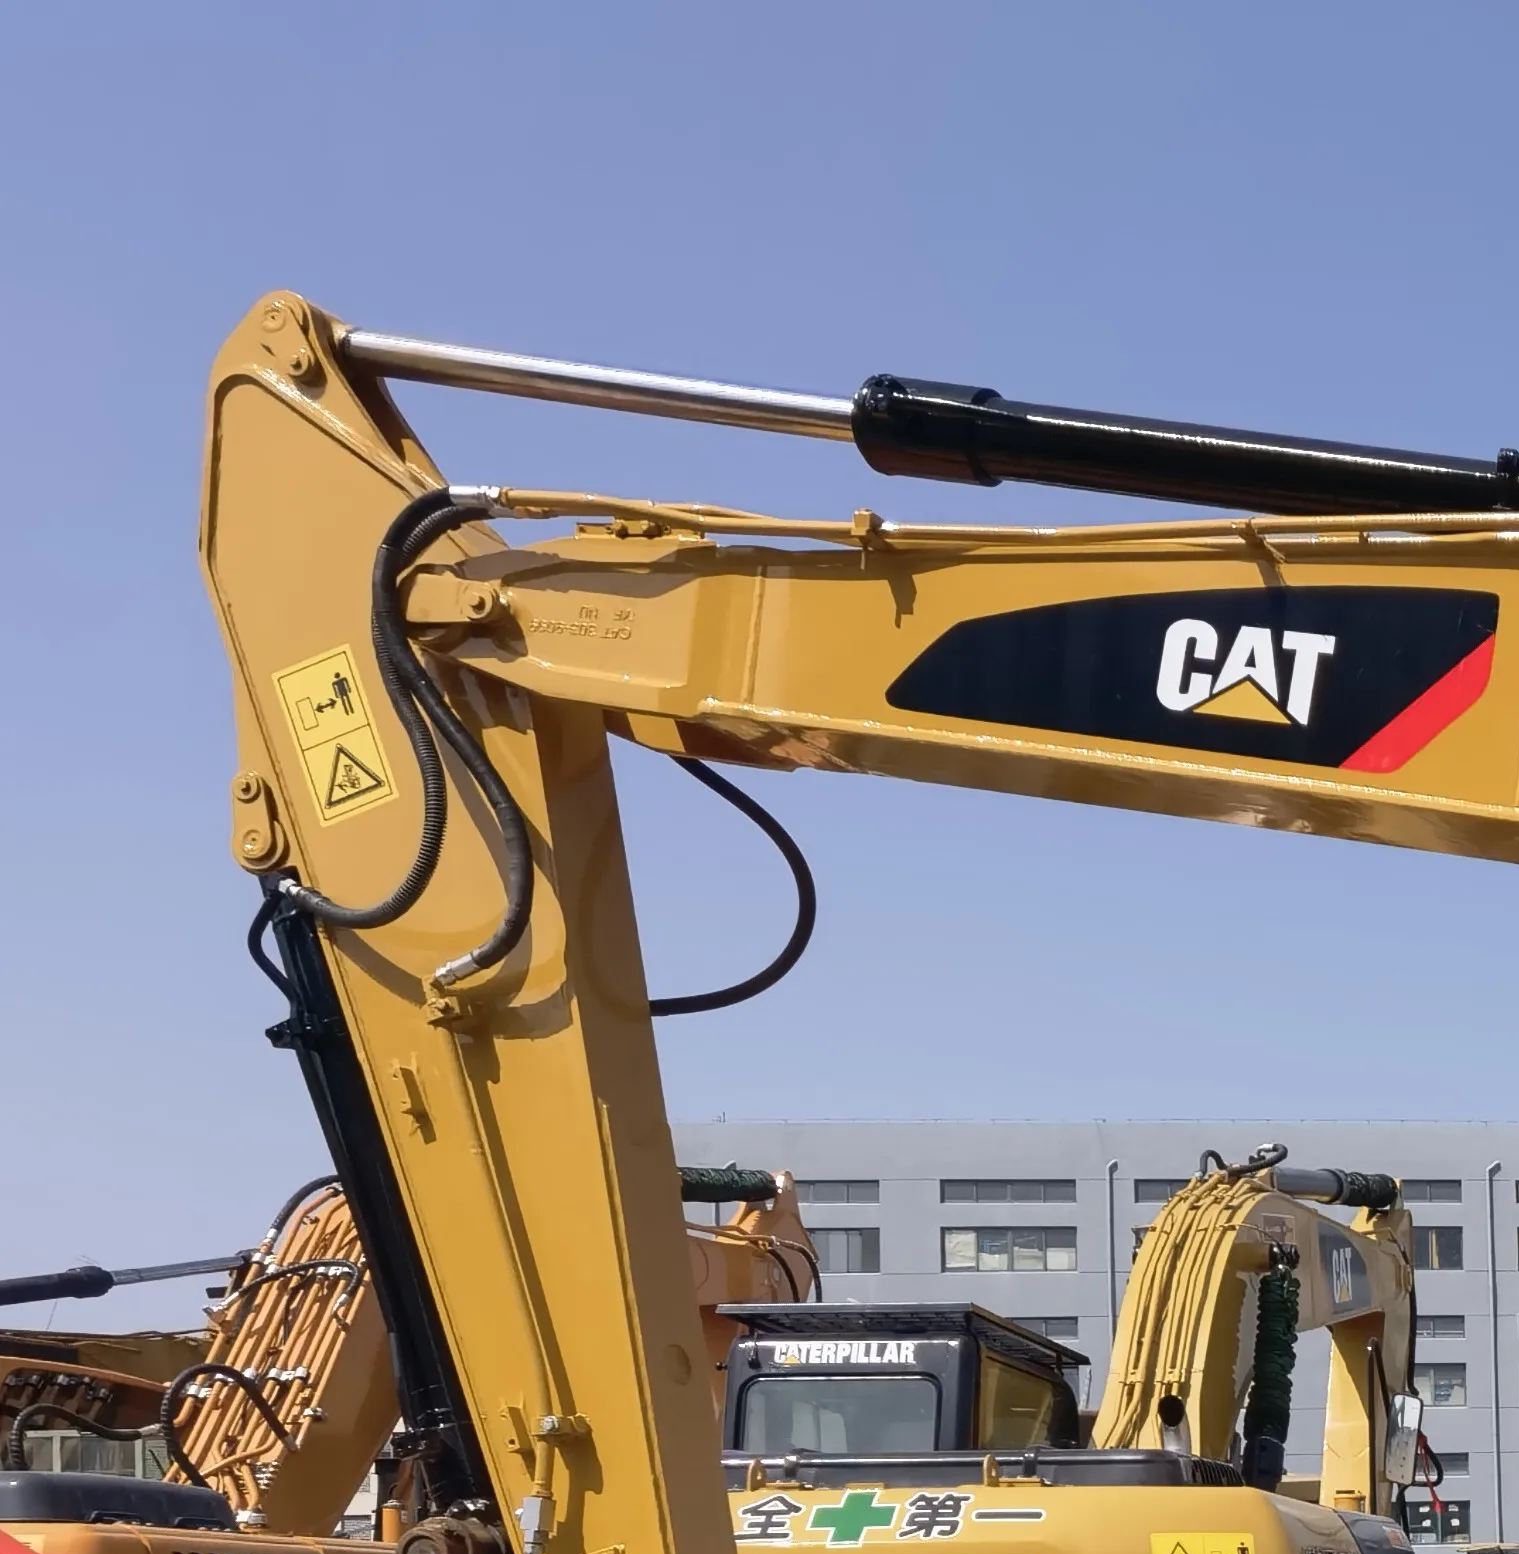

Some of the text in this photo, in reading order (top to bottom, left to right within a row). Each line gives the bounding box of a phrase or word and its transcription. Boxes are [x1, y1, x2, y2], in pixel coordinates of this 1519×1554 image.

[1156, 617, 1336, 727] CAT
[1332, 1247, 1352, 1303] CAT
[773, 1342, 916, 1365] CATERPILLAR
[734, 1493, 1047, 1542] 全 第一
